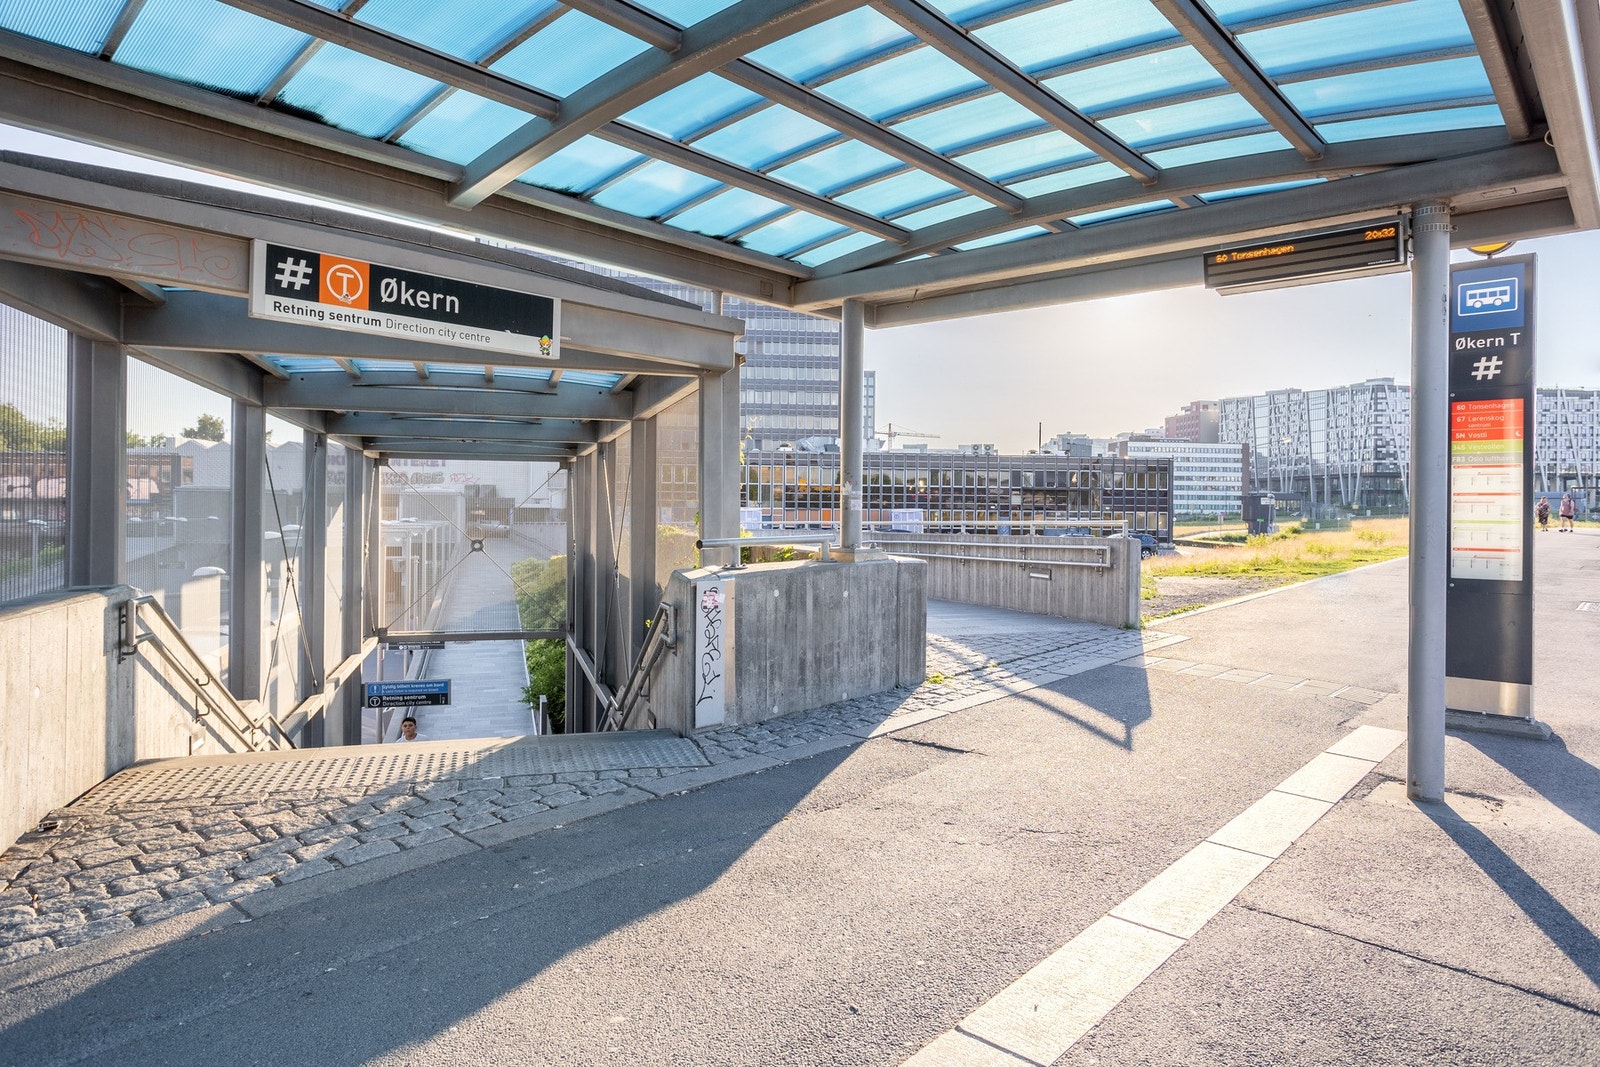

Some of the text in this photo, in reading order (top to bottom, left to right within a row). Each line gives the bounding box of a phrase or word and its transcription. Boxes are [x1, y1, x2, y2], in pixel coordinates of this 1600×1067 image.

[1365, 227, 1396, 240] 20:32
[1215, 245, 1295, 263] 60 Tonsenhagen
[380, 277, 460, 314] Økern
[273, 300, 491, 344] Retning sentrum Direction city centre
[1455, 332, 1521, 351] Økern T
[1468, 402, 1515, 411] Tonsenhagen
[1468, 414, 1505, 422] Lørenskog
